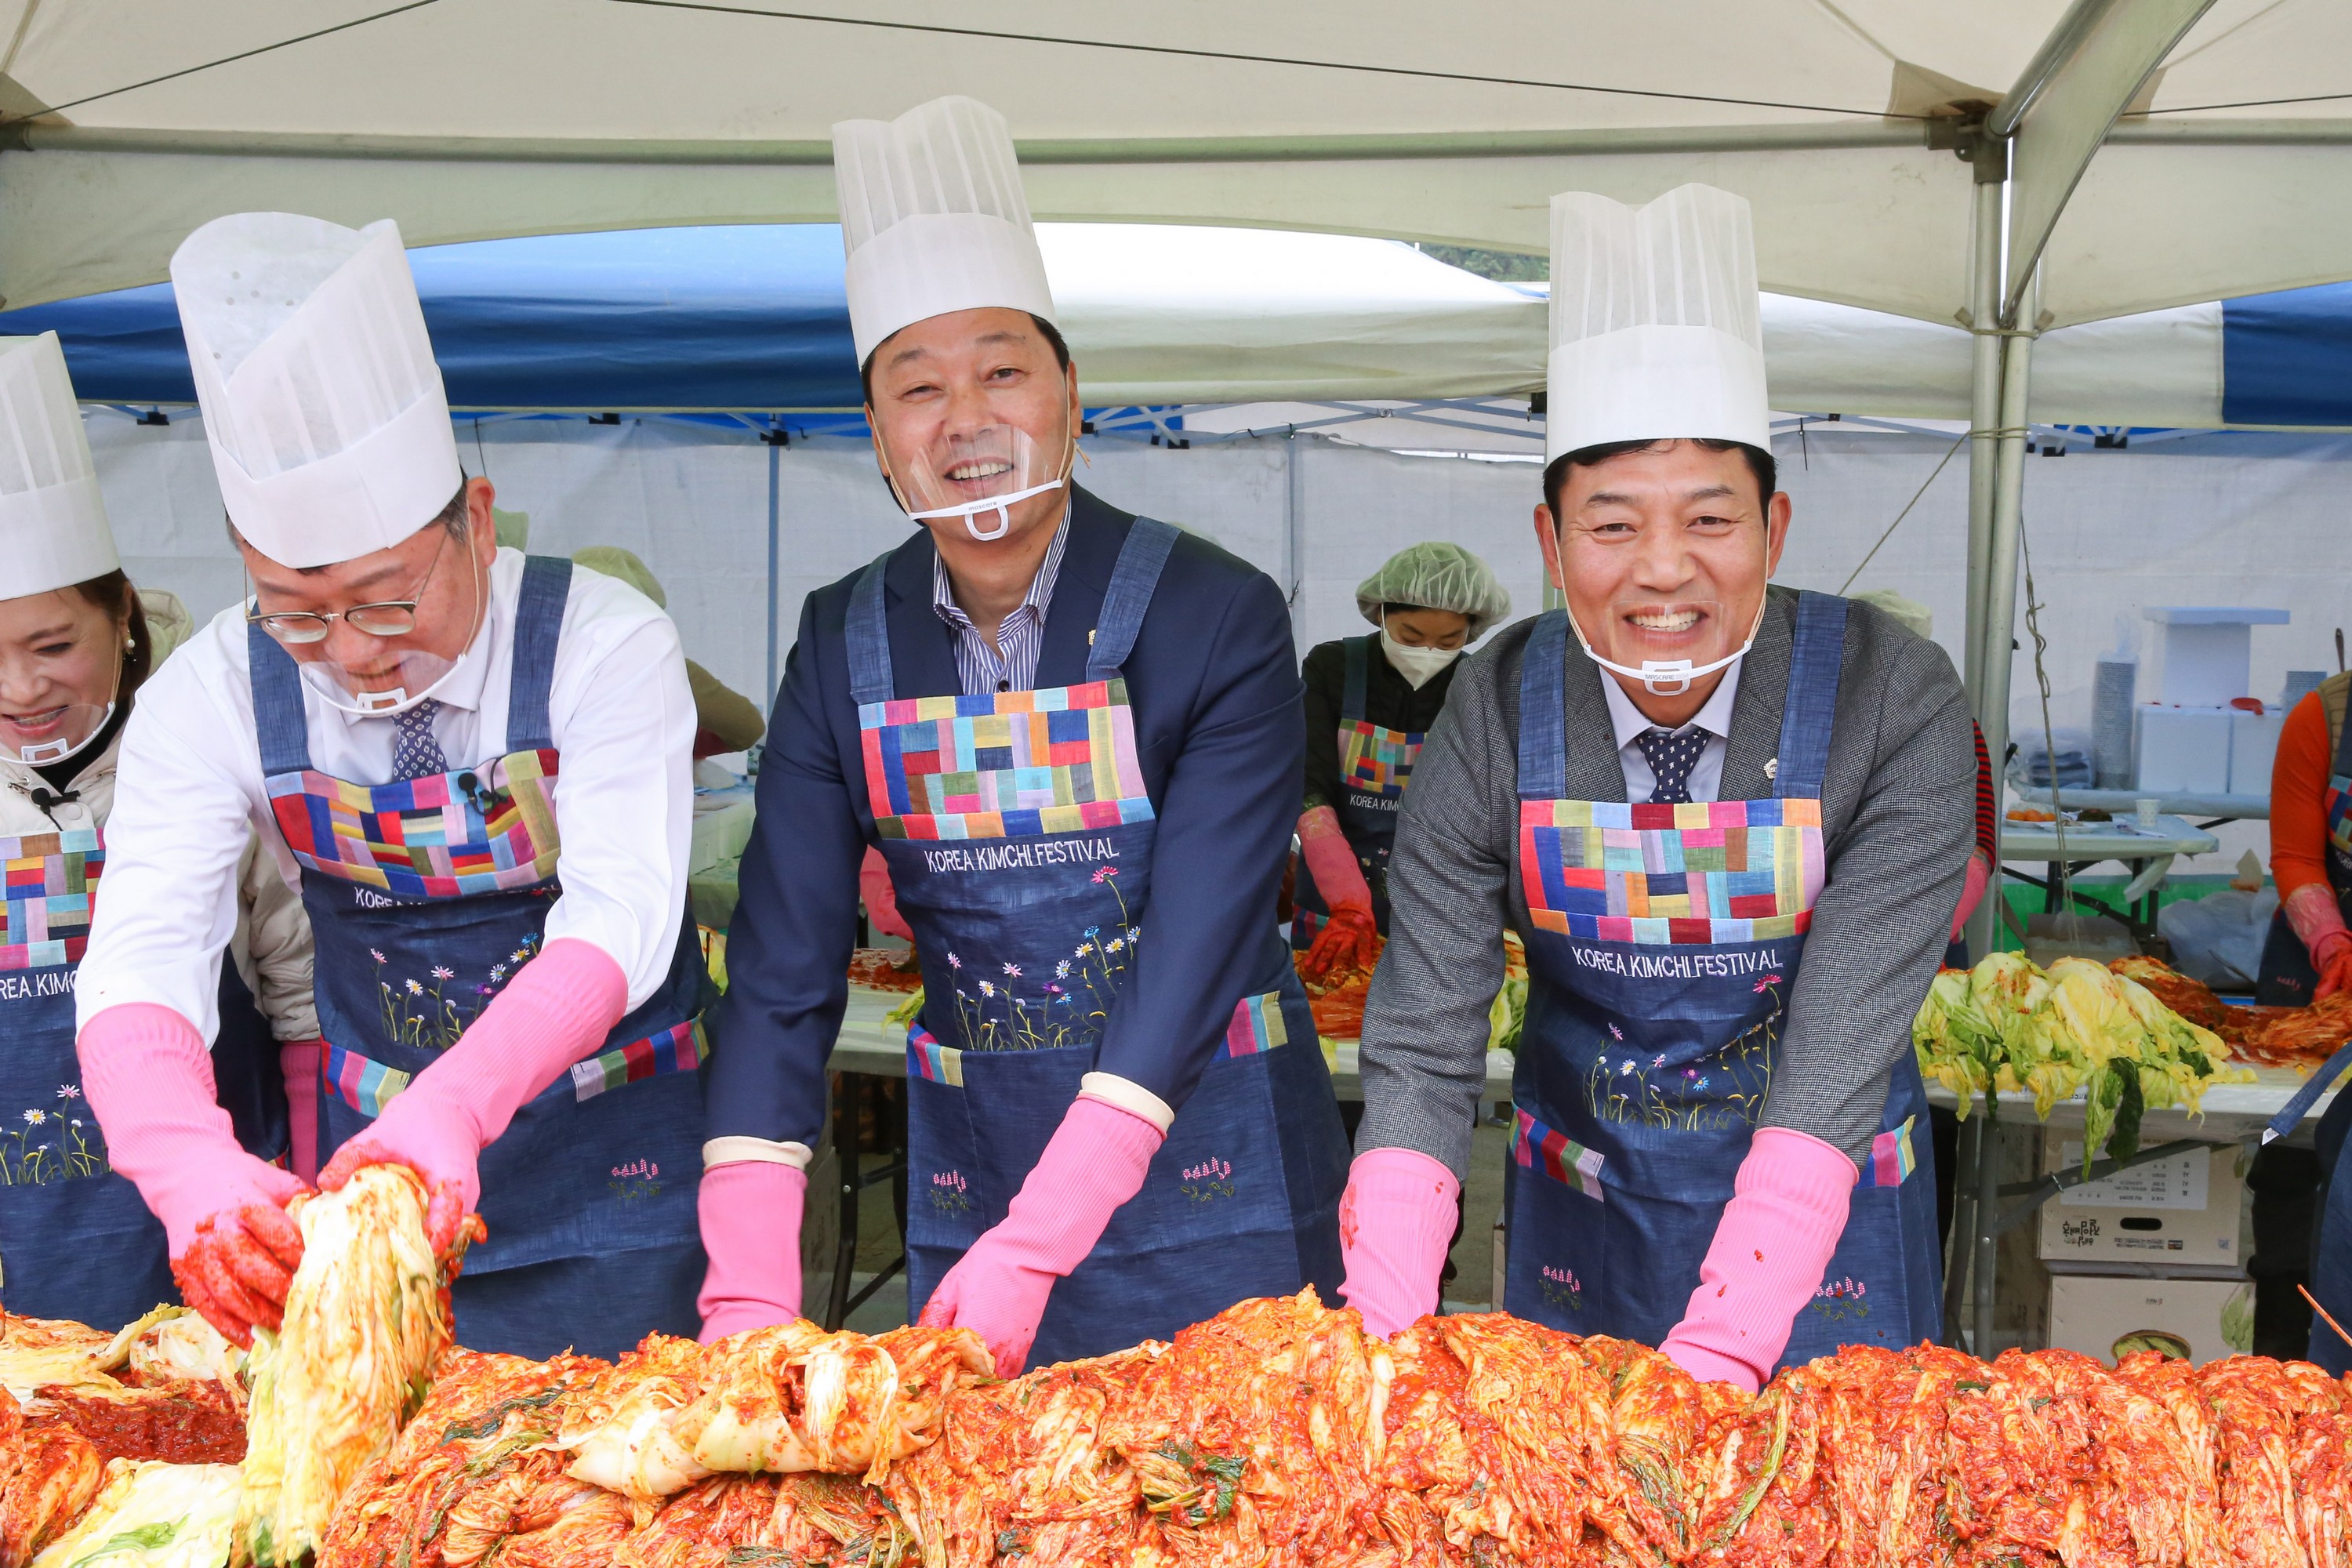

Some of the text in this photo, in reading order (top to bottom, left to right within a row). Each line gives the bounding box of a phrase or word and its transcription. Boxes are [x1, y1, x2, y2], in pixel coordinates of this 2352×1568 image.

[968, 502, 996, 510] mascare
[1349, 793, 1399, 811] KOREA KIM
[924, 837, 1120, 873] KOREA KIMCHI FESTIVAL
[354, 886, 403, 908] KORE
[1571, 946, 1784, 978] KOREA KIMCHI FESTIVAL
[2063, 1218, 2100, 1237] 절임배추
